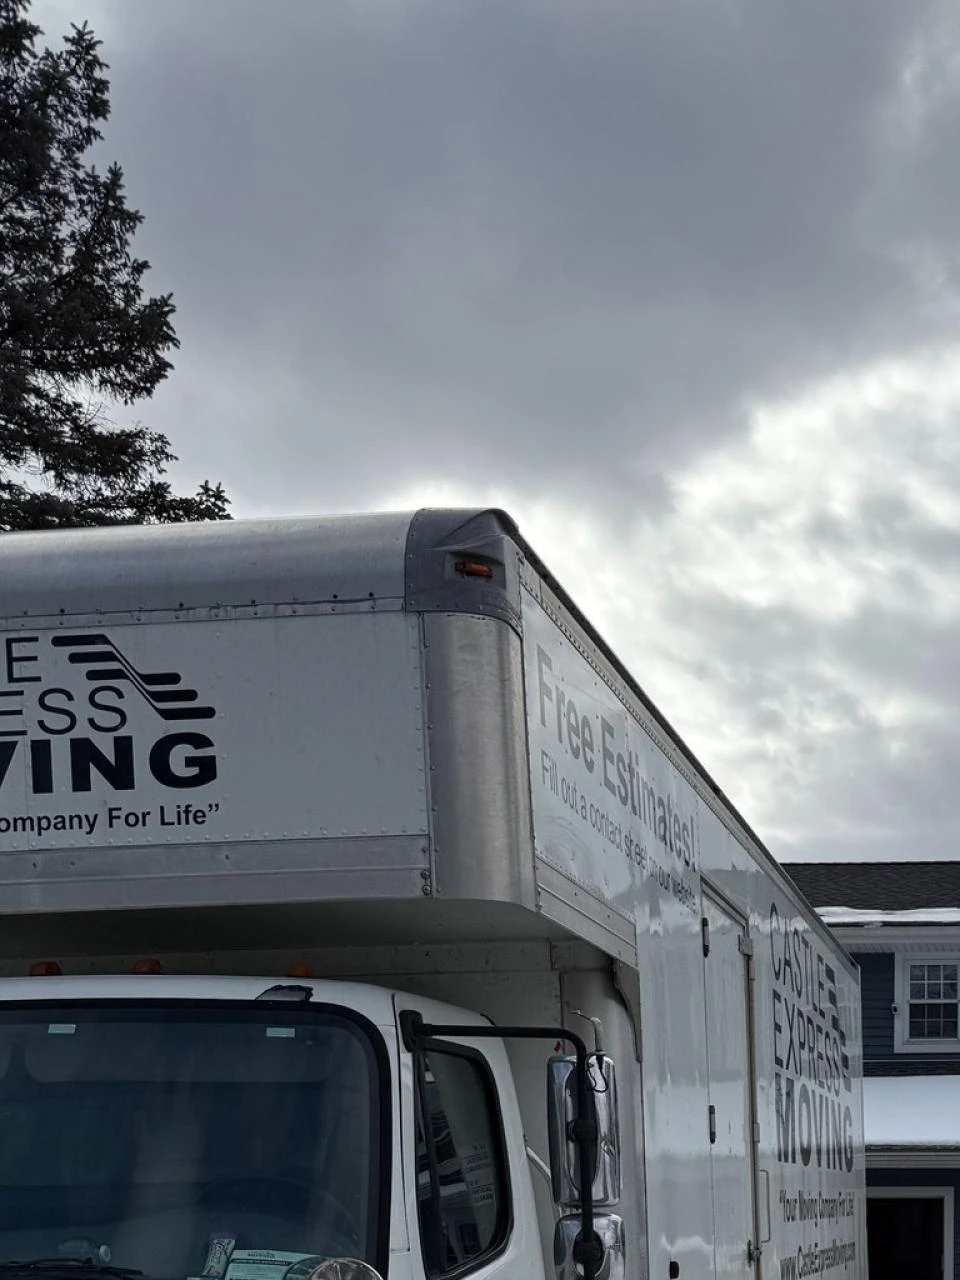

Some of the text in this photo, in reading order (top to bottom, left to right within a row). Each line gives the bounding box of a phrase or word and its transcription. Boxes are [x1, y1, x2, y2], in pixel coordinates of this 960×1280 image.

[537, 643, 698, 873] Free Estimates!
[541, 749, 559, 797] Fill
[561, 777, 579, 815] out
[580, 795, 588, 820] a
[590, 803, 623, 853] contact
[108, 807, 151, 828] For
[770, 902, 826, 1019] CASTLE
[773, 988, 841, 1097] EXPRESS
[774, 1072, 854, 1173] MOVING
[798, 1189, 818, 1228] Moving
